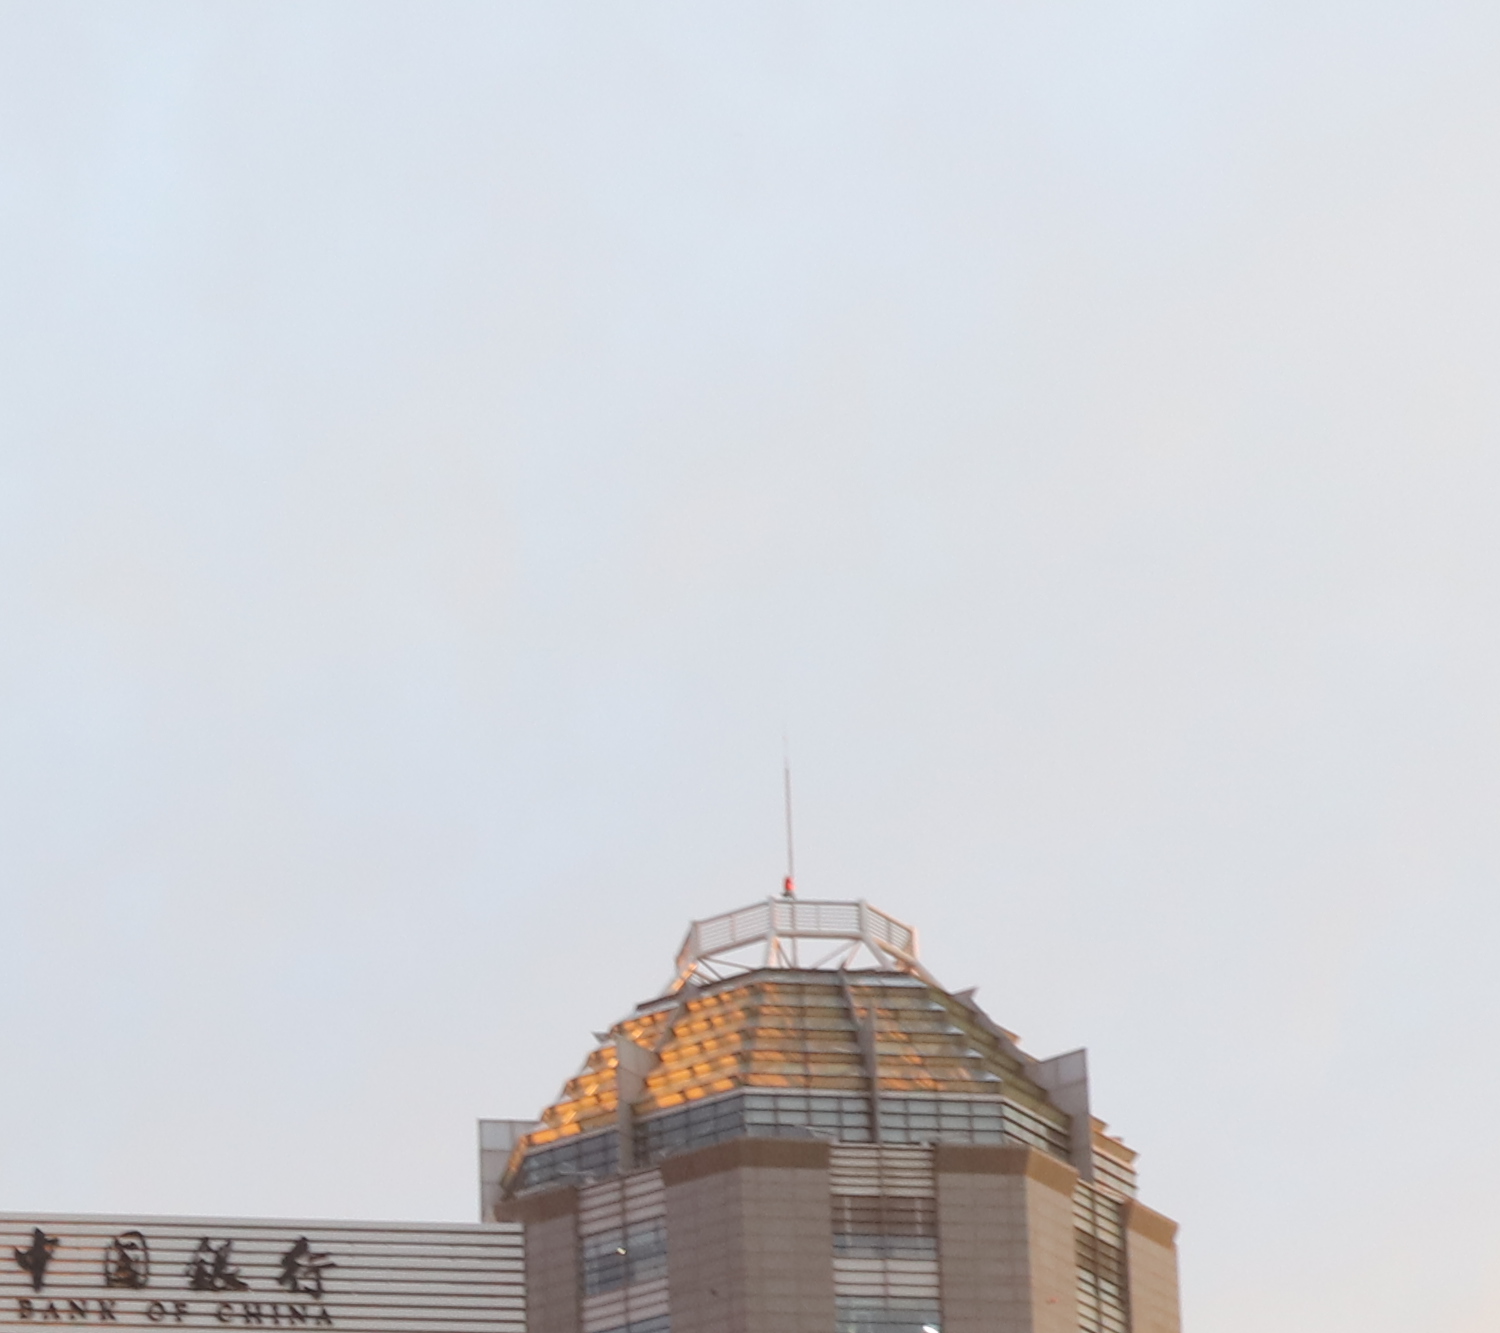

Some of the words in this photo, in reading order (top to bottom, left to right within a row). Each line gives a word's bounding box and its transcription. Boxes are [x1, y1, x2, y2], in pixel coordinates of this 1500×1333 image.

[16, 1298, 118, 1322] BANK
[146, 1300, 191, 1324] OF
[215, 1302, 335, 1327] CHINA
